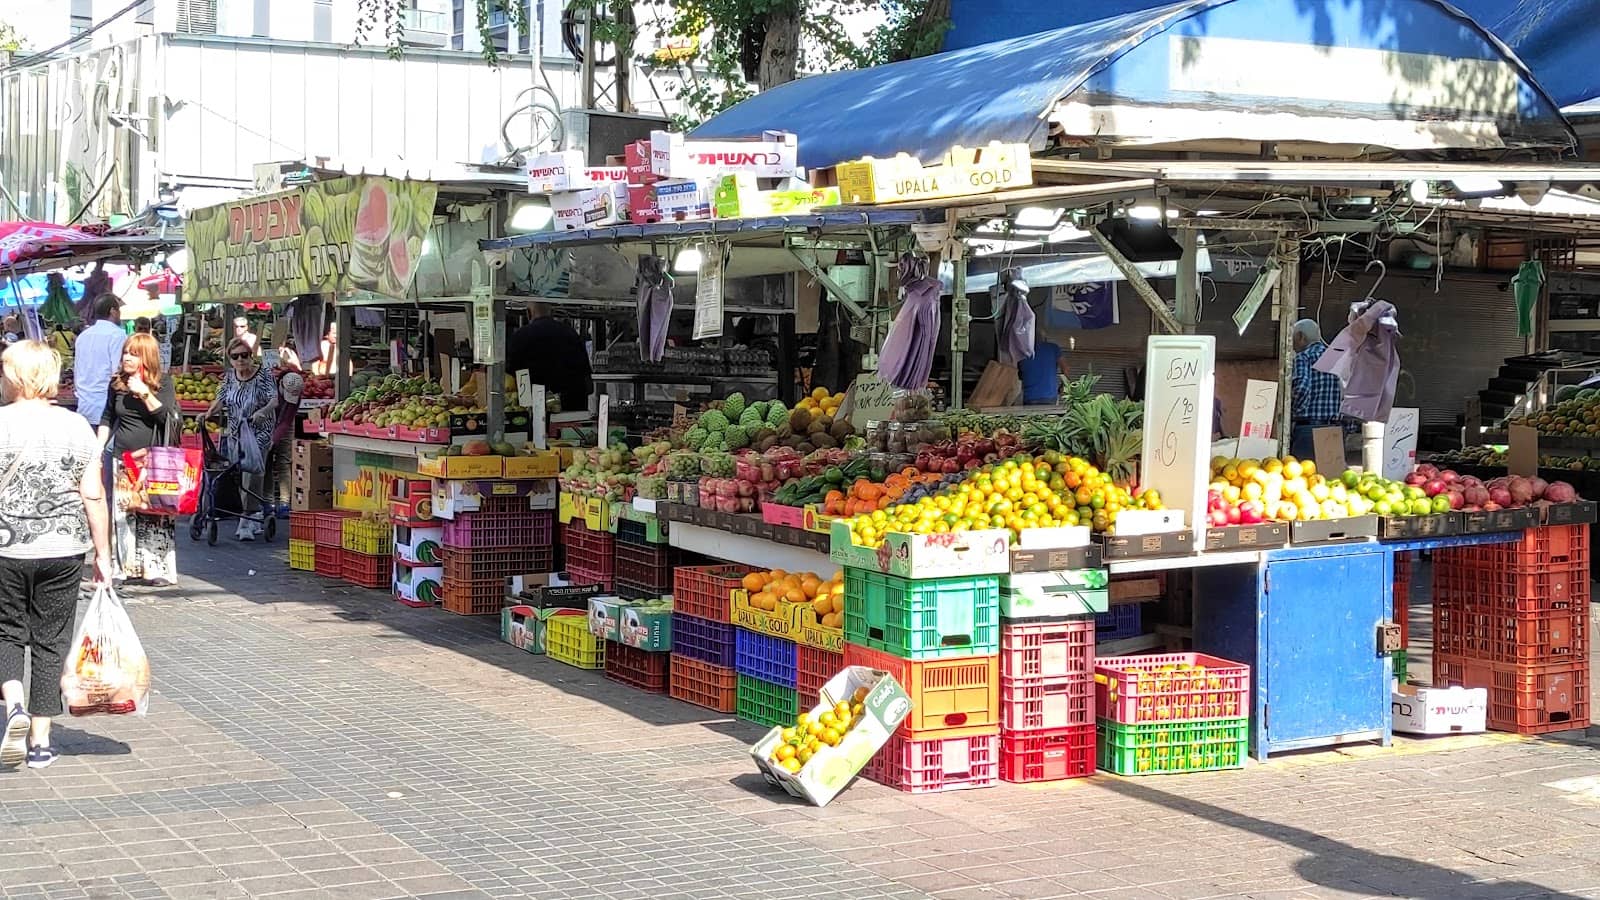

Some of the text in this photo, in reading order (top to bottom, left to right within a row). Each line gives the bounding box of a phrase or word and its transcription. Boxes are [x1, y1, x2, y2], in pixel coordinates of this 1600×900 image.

[896, 169, 1012, 195] UPALA GOLD
[230, 194, 301, 246] אבטיח
[265, 247, 301, 281] אדום
[310, 242, 349, 286] ירוק
[1253, 387, 1273, 410] 5
[738, 610, 789, 634] UPALA GOLD
[804, 628, 824, 646] UPALA
